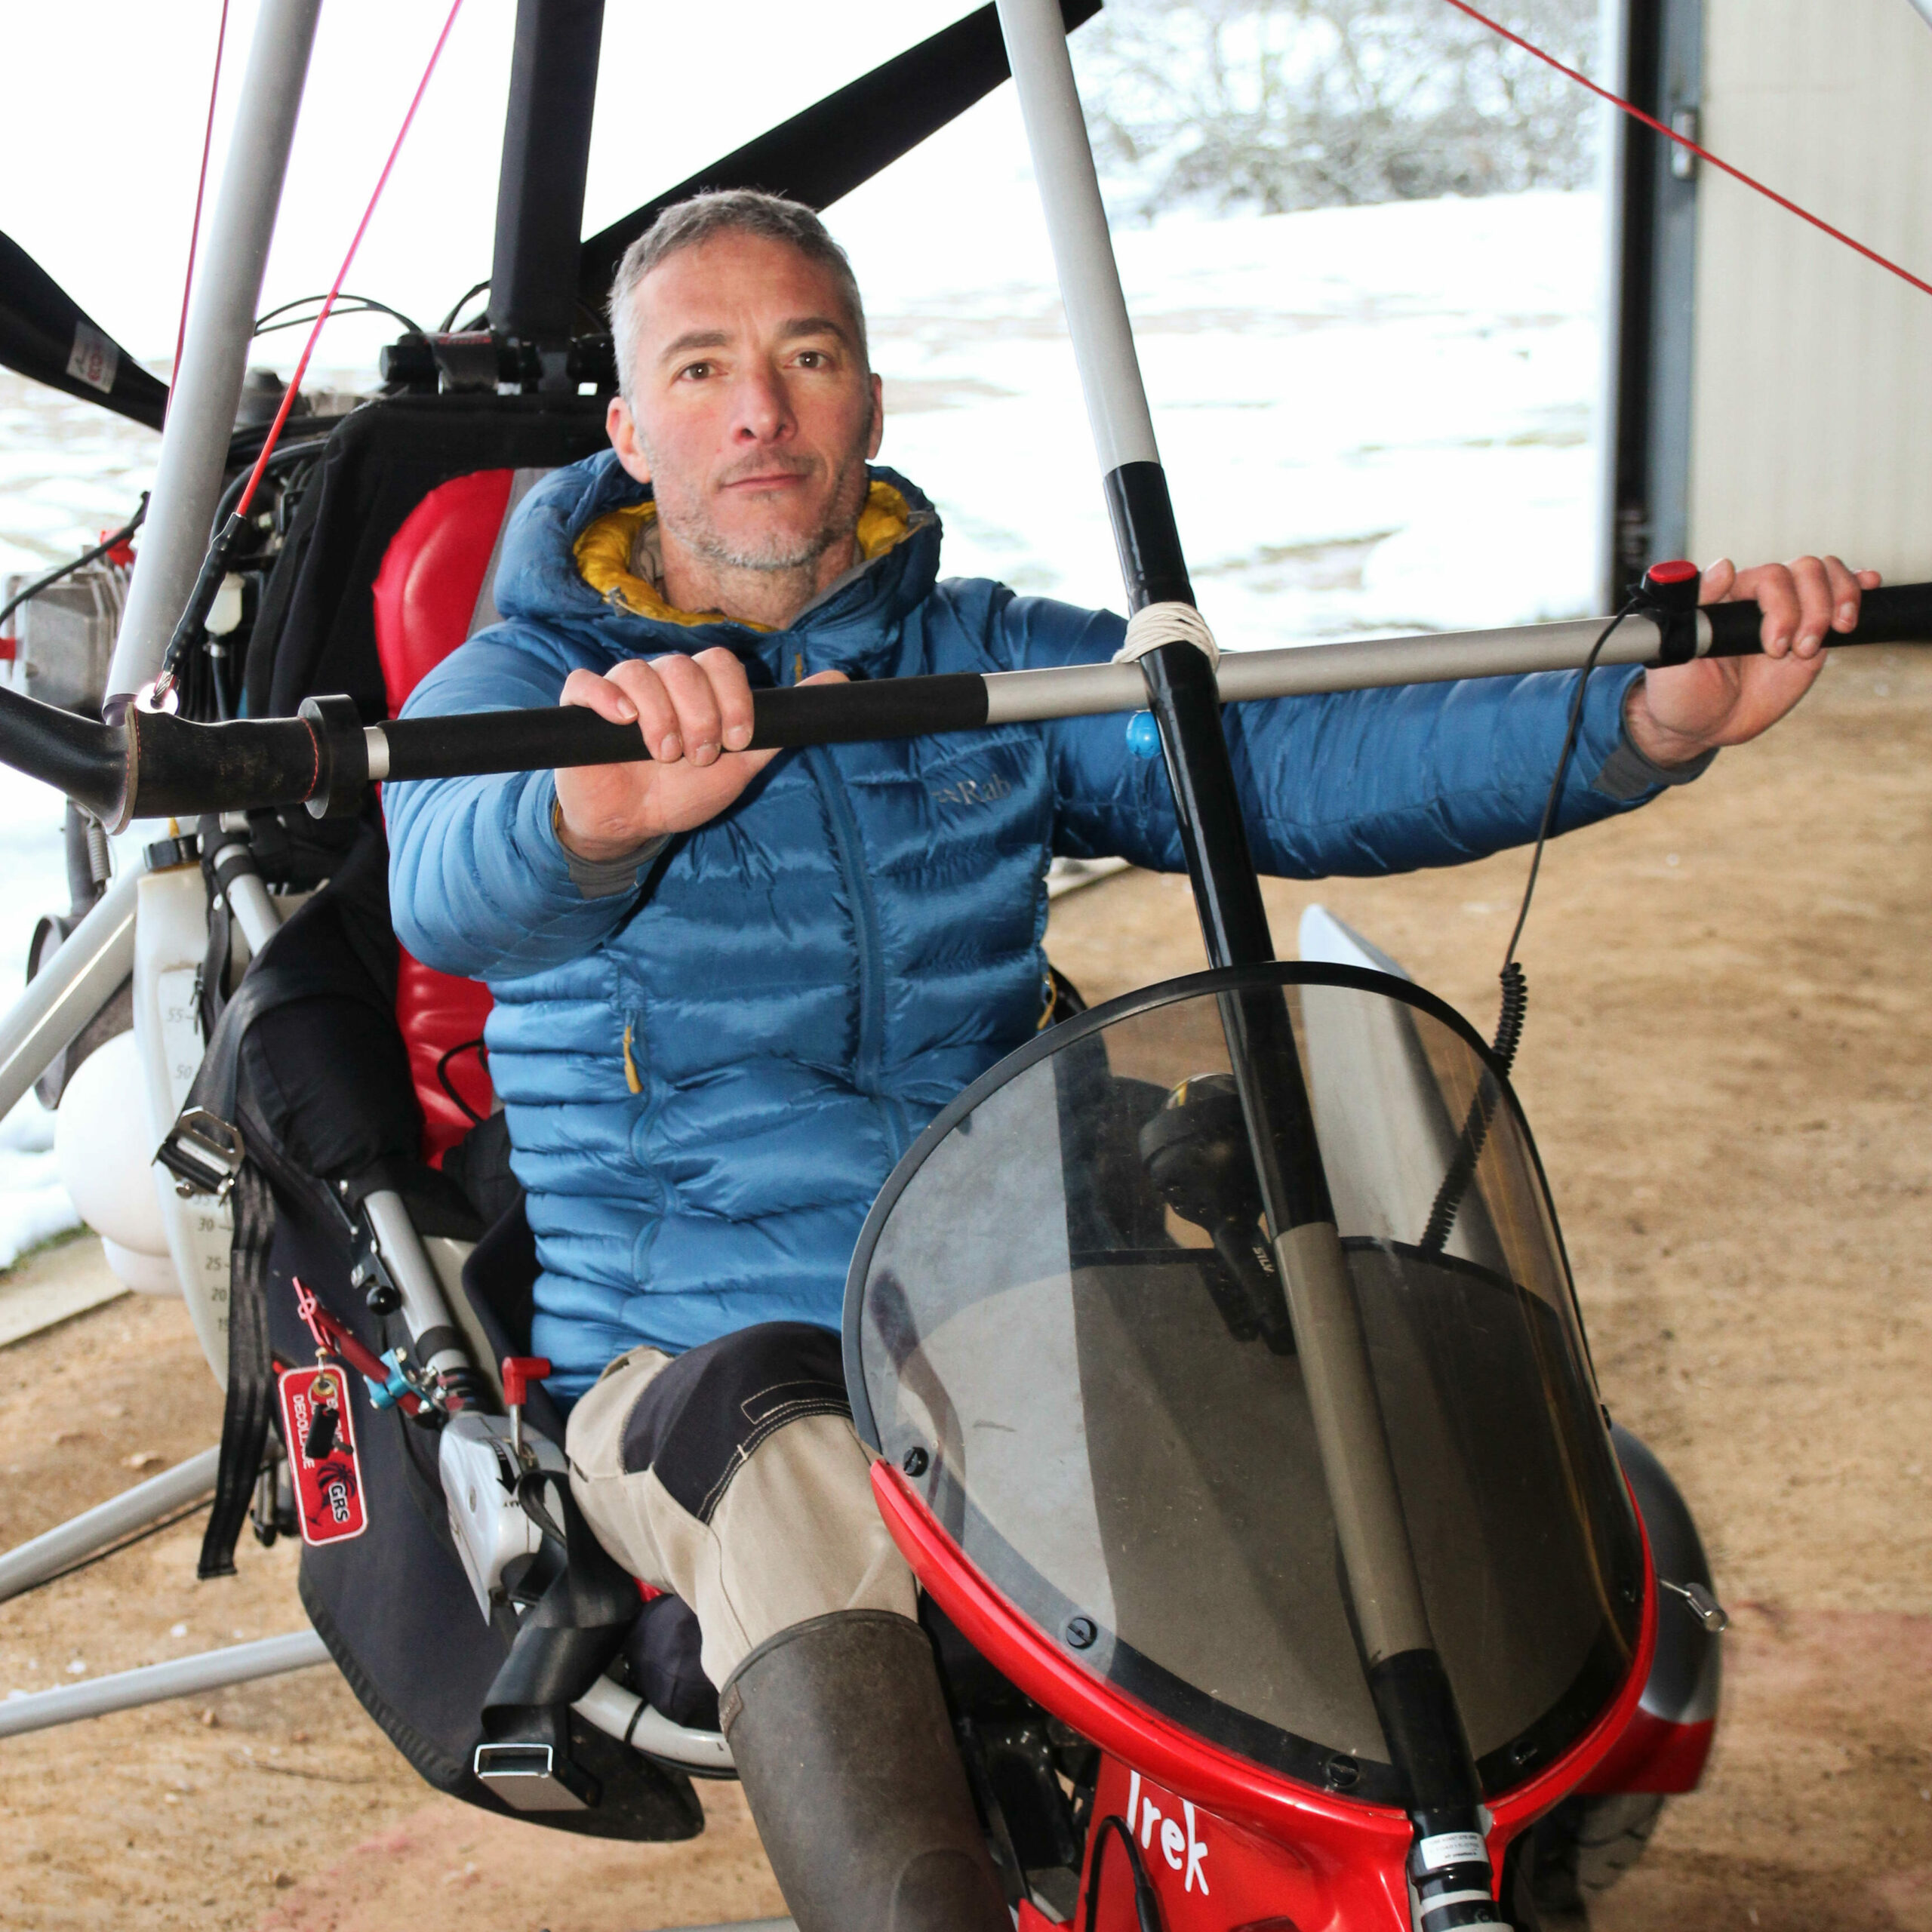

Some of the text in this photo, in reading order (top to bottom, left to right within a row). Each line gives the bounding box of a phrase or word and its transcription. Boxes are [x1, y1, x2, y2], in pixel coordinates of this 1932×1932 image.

[957, 773, 1011, 805] Rab
[167, 1008, 184, 1023] 55
[175, 1063, 192, 1079] 50
[198, 1217, 215, 1232] 30
[205, 1257, 221, 1271] 25
[211, 1287, 227, 1302] 20
[330, 1482, 349, 1524] GRS
